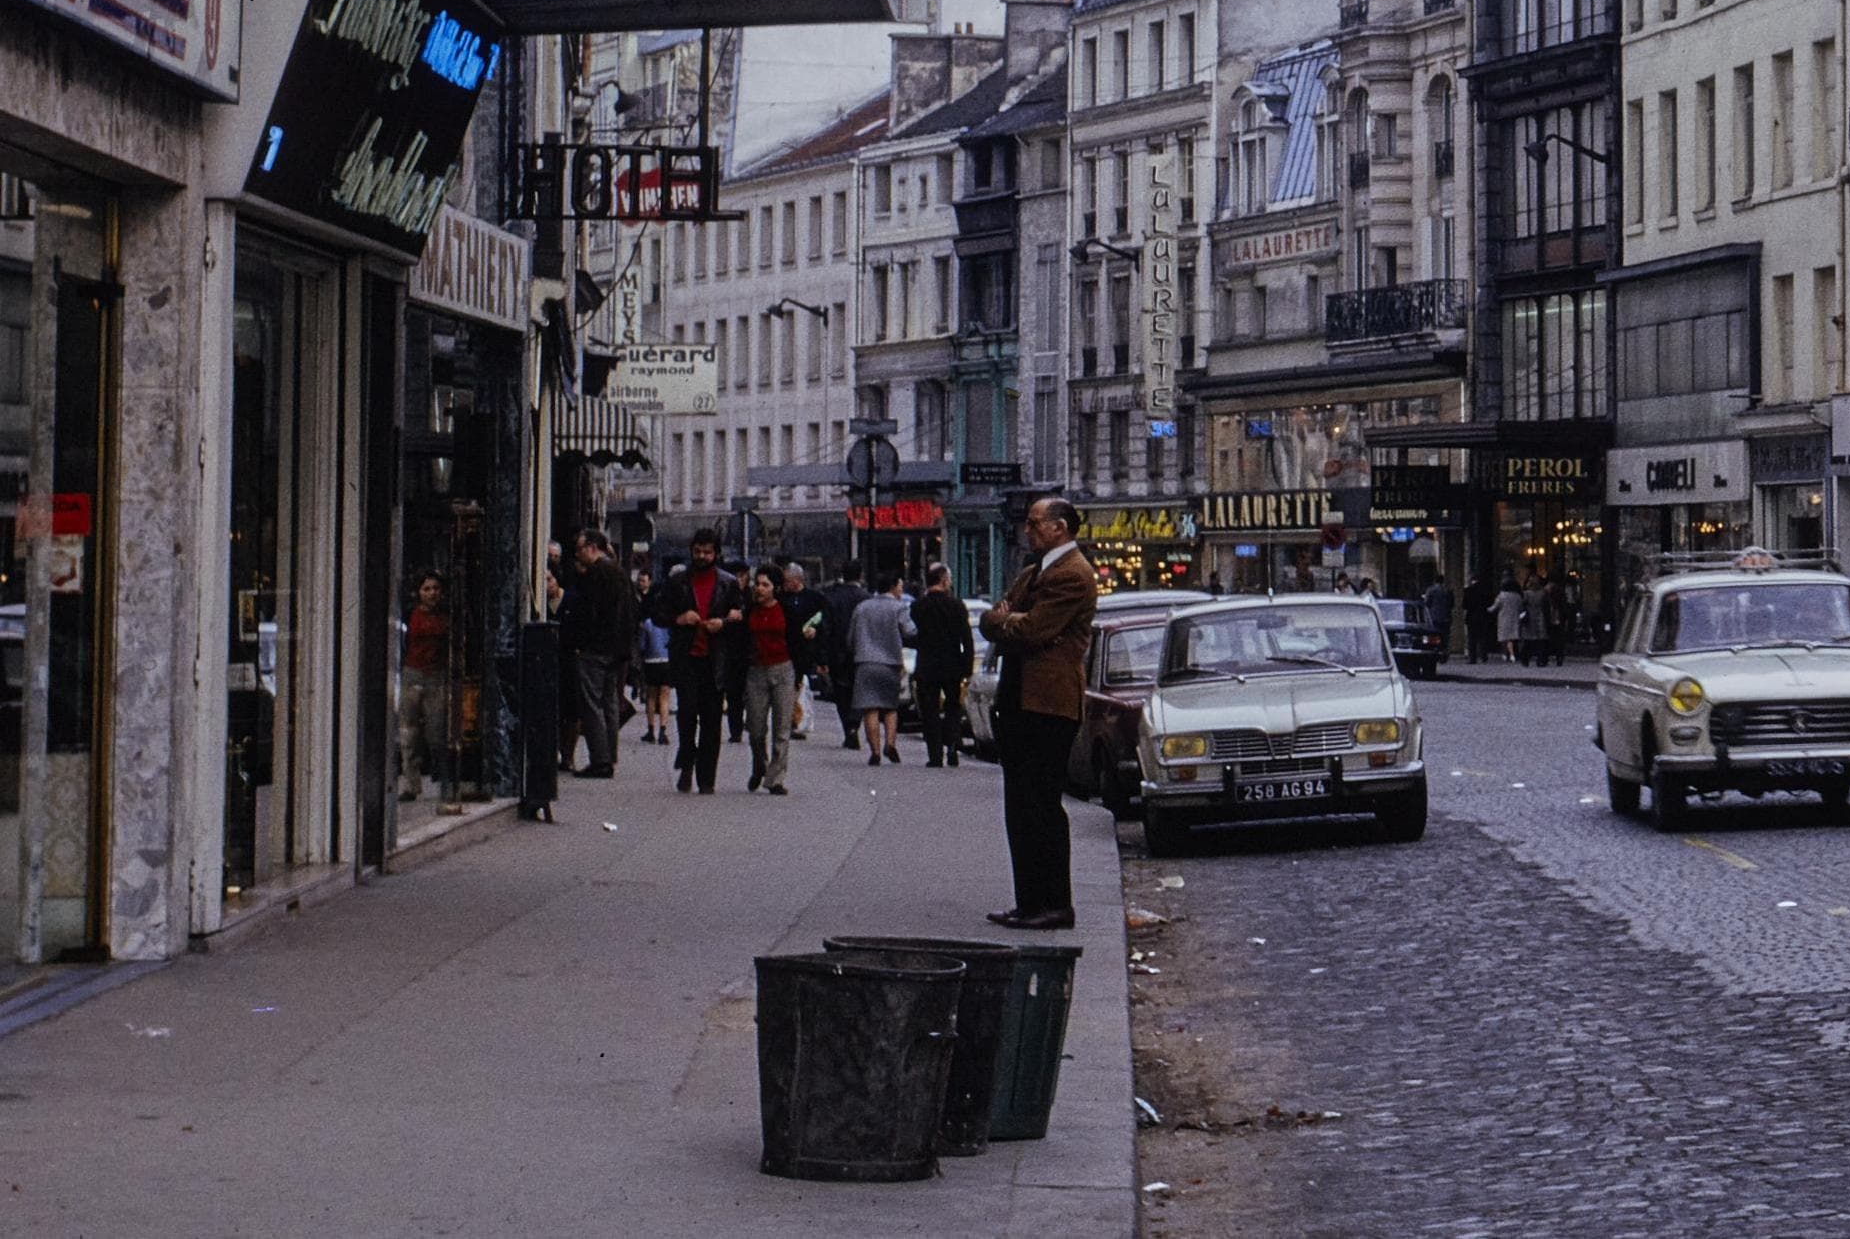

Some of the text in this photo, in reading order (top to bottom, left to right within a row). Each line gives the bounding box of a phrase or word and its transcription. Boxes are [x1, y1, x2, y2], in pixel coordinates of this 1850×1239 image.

[522, 145, 745, 220] HOTEL
[1232, 227, 1332, 263] LALAURETTE
[631, 366, 696, 376] raymond
[1507, 457, 1588, 479] PEROL
[1507, 480, 1575, 495] FRERES
[1202, 491, 1333, 528] LALAURETTE
[1244, 780, 1325, 802] 258 AG 94
